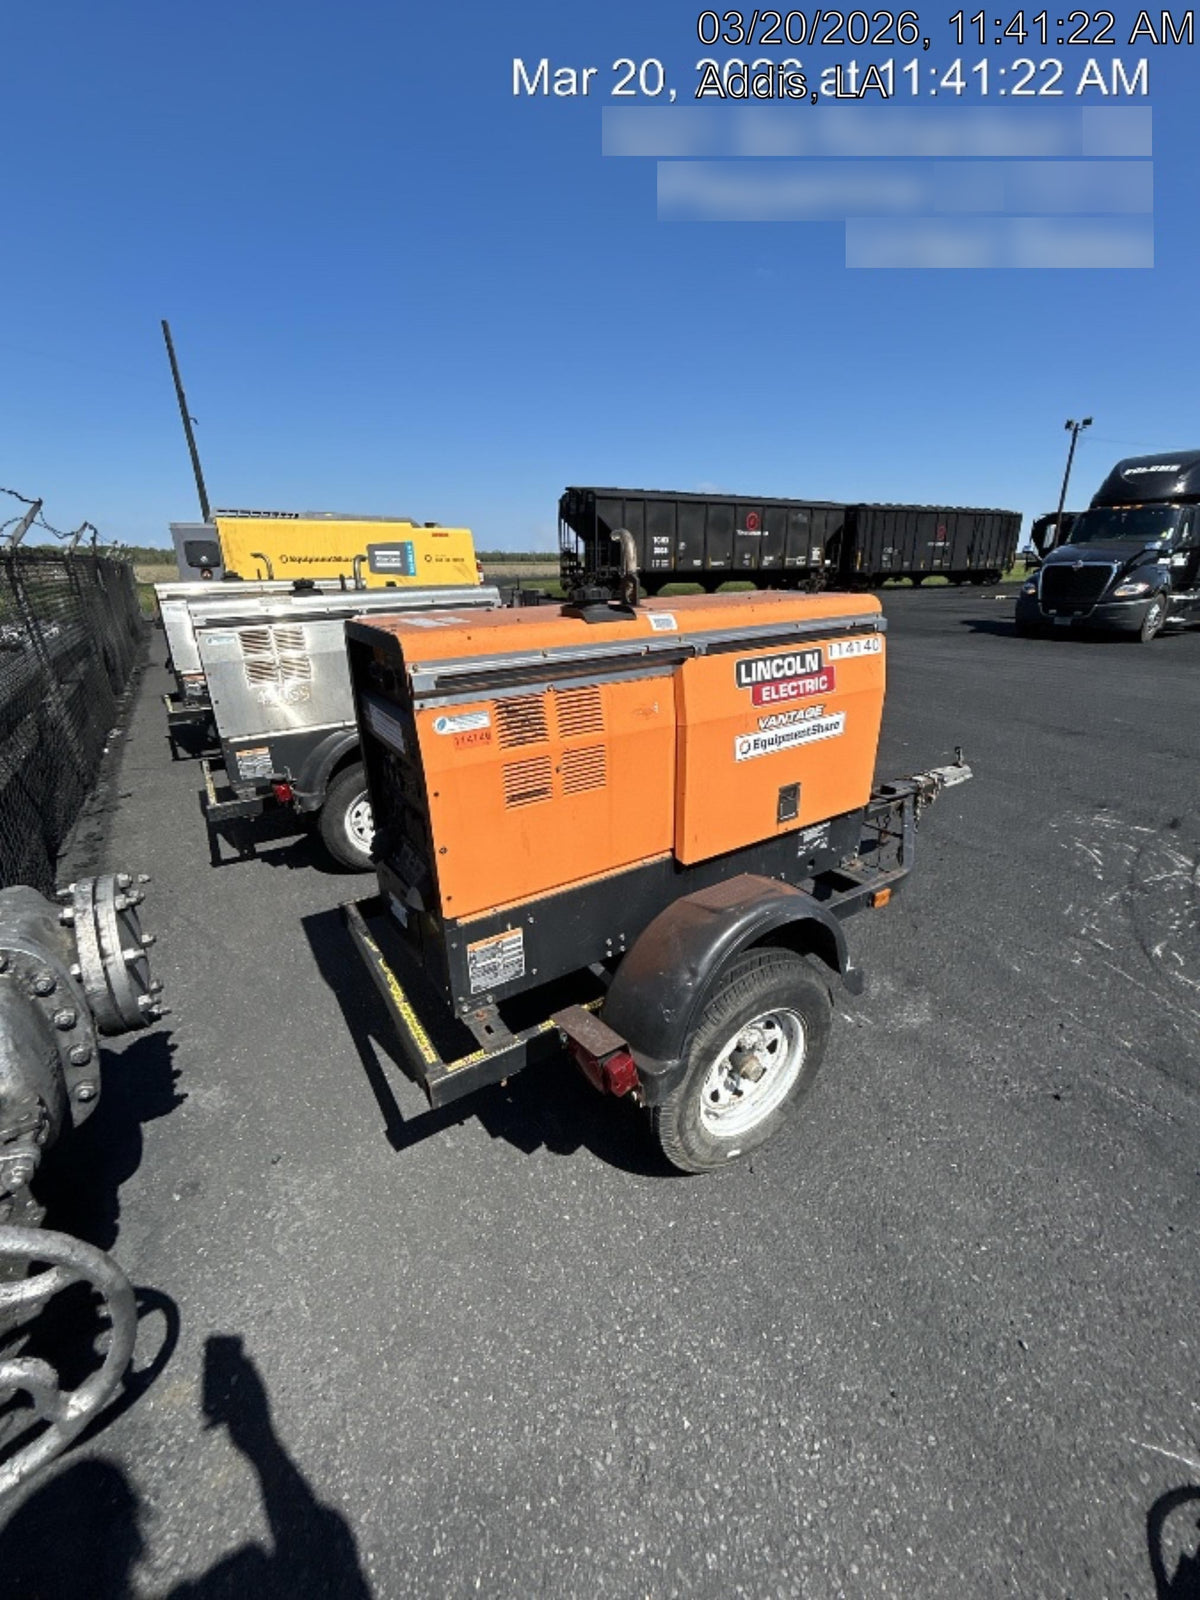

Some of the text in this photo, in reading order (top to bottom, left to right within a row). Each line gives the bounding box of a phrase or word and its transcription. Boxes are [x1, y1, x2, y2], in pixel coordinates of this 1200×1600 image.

[828, 638, 880, 657] 114140
[740, 652, 819, 684] LINCOLN
[761, 675, 828, 702] ELECTRIC
[757, 704, 826, 731] VANTAGE
[753, 720, 841, 751] EquipmentShare
